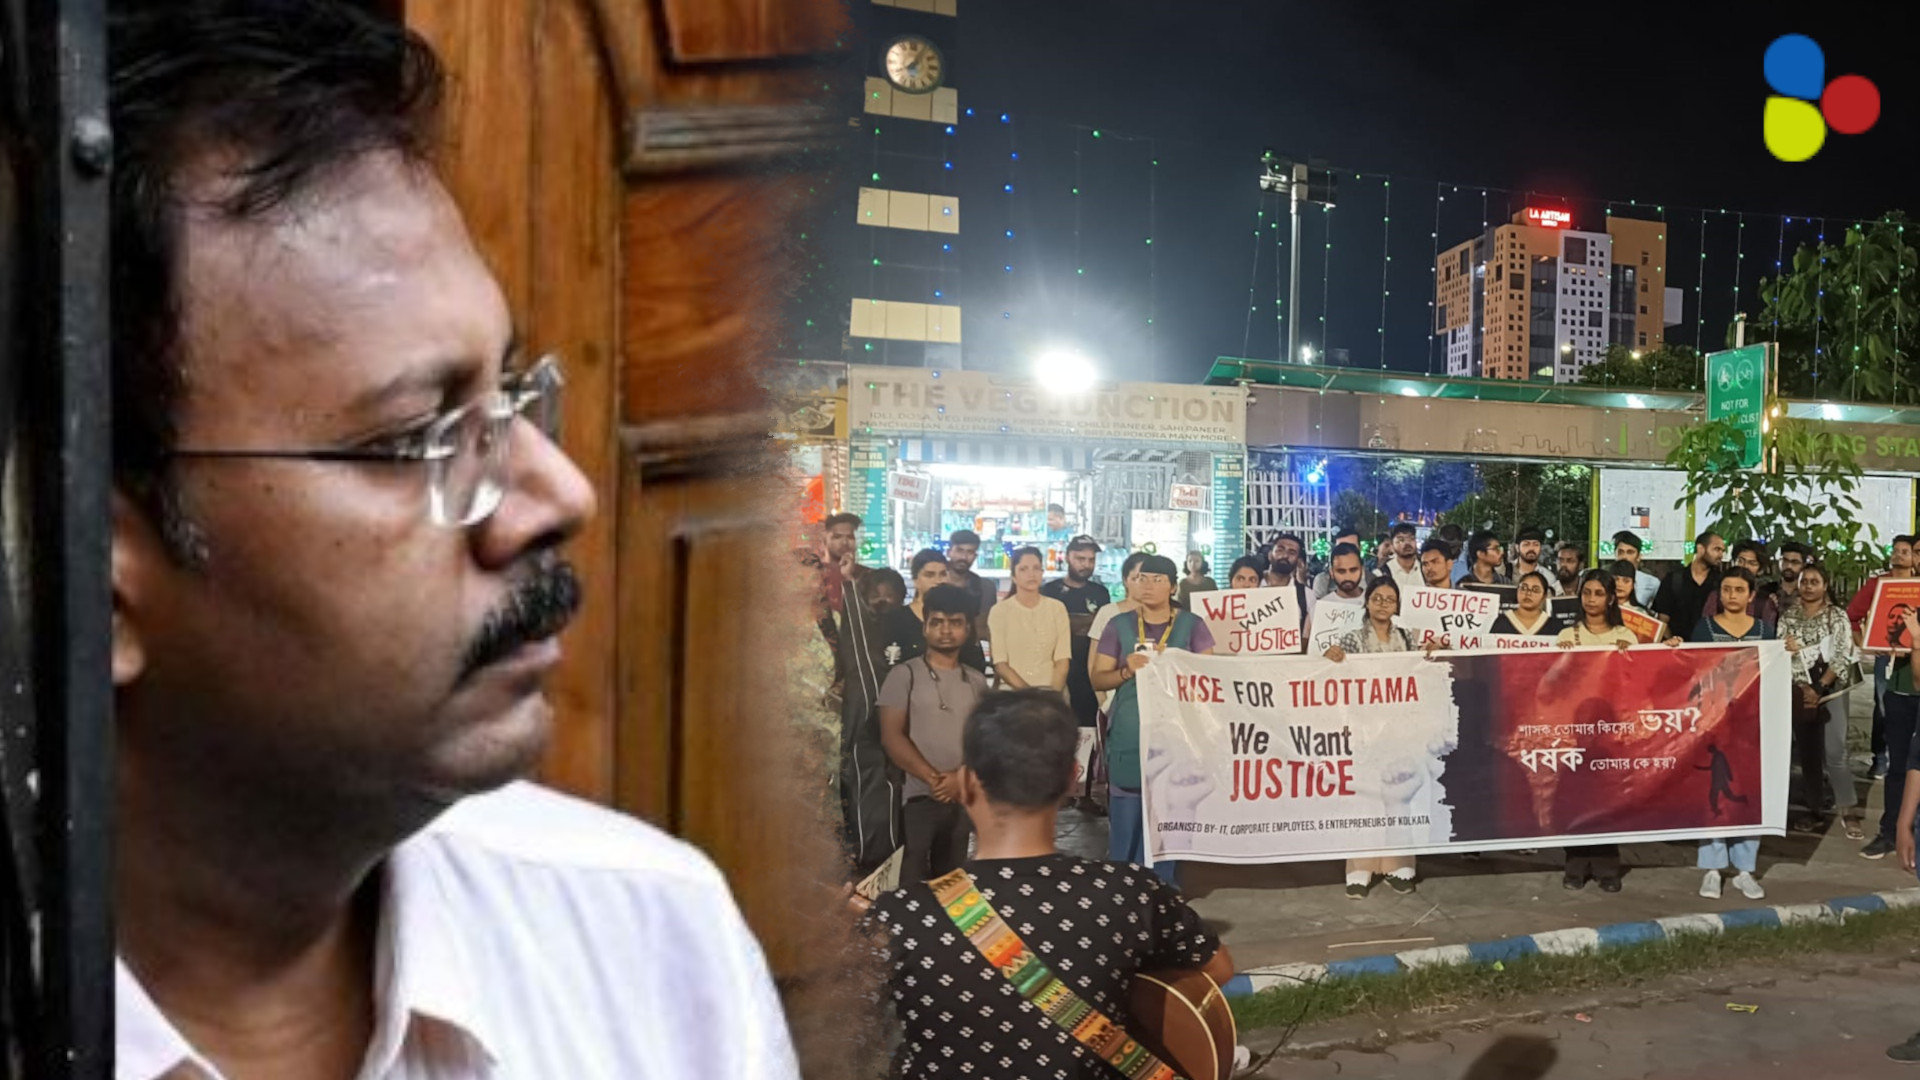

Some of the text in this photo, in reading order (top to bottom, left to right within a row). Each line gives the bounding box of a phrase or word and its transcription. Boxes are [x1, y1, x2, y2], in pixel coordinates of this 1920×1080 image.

[1529, 208, 1539, 219] LA
[864, 381, 1234, 422] THE VEG JUNCTION
[1720, 398, 1749, 411] NOT FOR
[937, 414, 959, 423] VEG
[1169, 432, 1198, 440] MANY
[1876, 435, 1920, 457] STA
[1202, 593, 1248, 621] WE
[1239, 596, 1285, 632] WANT
[1411, 591, 1491, 615] JUSTICE
[1440, 613, 1482, 632] FOR
[1228, 627, 1300, 653] JUSTICE
[1459, 634, 1483, 649] KA
[1176, 674, 1419, 708] RISE FOR TILOTTAMA
[1553, 722, 1595, 737] তোমার
[1597, 719, 1636, 735] কিসের
[1637, 706, 1703, 734] ভয়?
[1229, 721, 1353, 757] We Want
[1519, 737, 1677, 773] ধর্ষক তোমার কে হয়?
[1229, 758, 1357, 803] JUSTICE
[1157, 821, 1203, 833] ORGANISED
[1230, 823, 1271, 836] CORPORATE
[1272, 819, 1317, 833] EMPLOYEES,
[1318, 819, 1325, 831] &
[1325, 815, 1387, 830] ENTREPRENEURS
[1387, 815, 1398, 827] OF
[1399, 814, 1431, 827] KOLKATA
